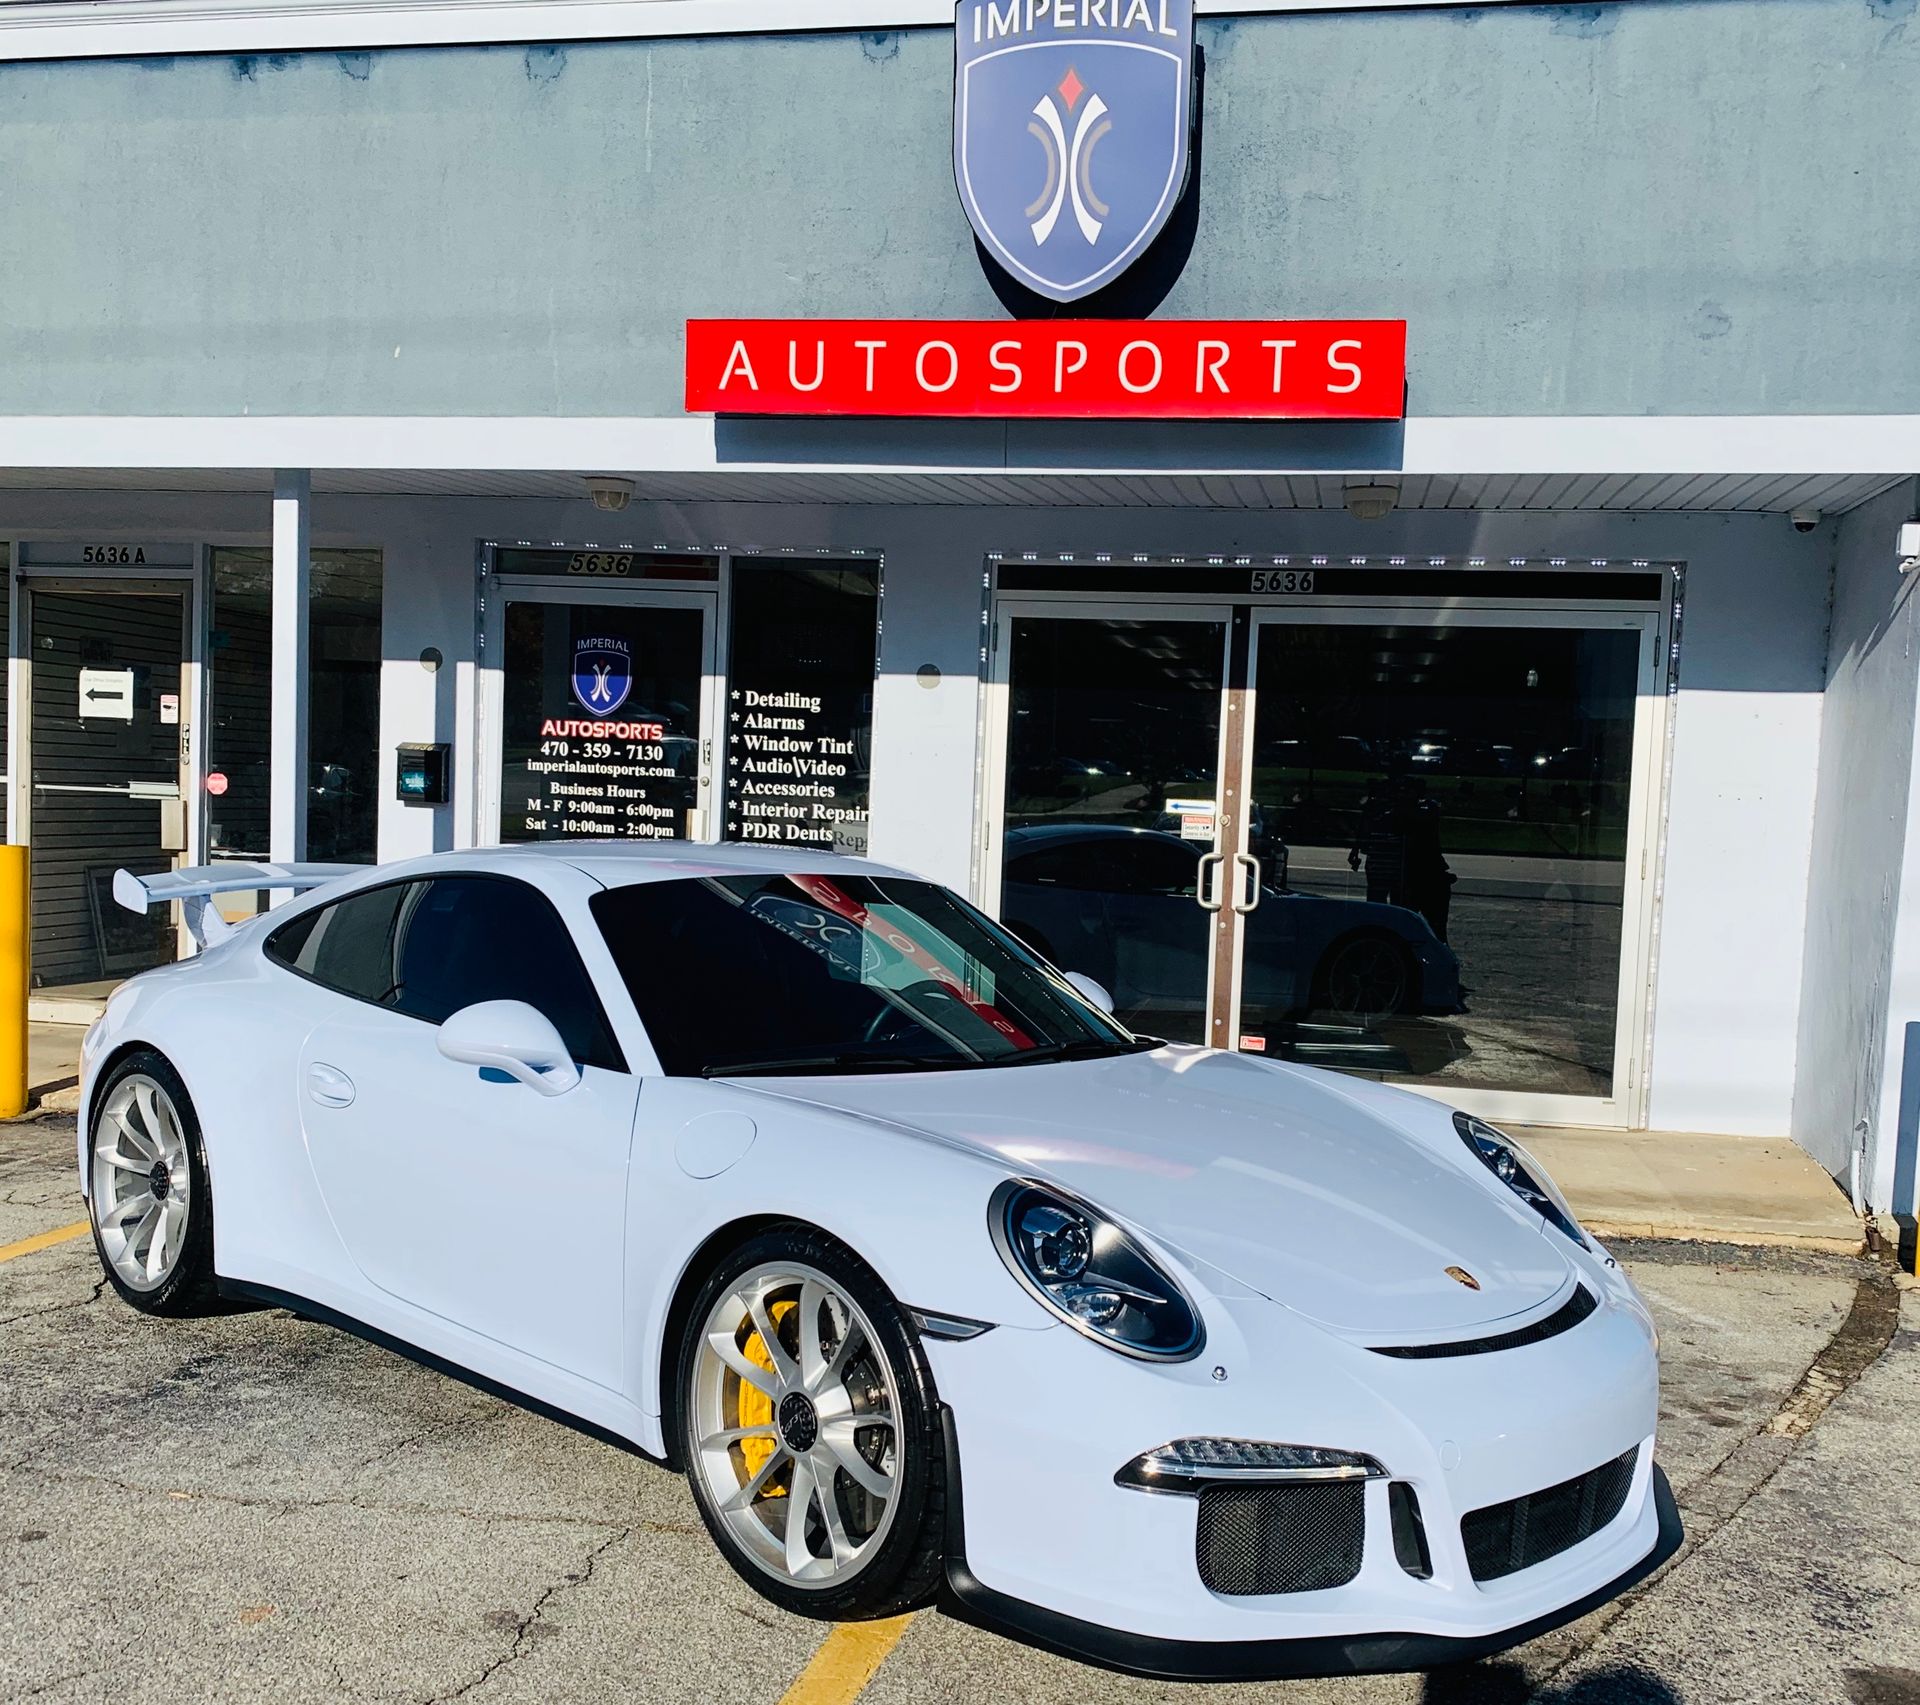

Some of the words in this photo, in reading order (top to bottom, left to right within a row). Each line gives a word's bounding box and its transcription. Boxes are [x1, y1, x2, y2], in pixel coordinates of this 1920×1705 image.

[974, 0, 1178, 43] IMPERIAL
[718, 339, 1364, 395] AUTOSPORTS
[83, 546, 130, 563] 5636
[134, 547, 146, 563] A
[571, 554, 631, 574] 5636
[1252, 571, 1313, 592] 5636
[577, 638, 630, 653] IMPERIAL
[745, 690, 821, 713] Detailing
[541, 720, 664, 741] AUTOSPORTS
[743, 713, 805, 731] Alarms
[540, 741, 569, 757] 470
[582, 742, 611, 758] 359
[626, 744, 664, 761] 7130
[743, 734, 814, 753] Window
[817, 737, 854, 755] Tint
[527, 759, 676, 778] imperialautosports.com
[742, 756, 846, 778] Audio\Video
[550, 782, 604, 797] Business
[606, 784, 646, 799] Hours
[741, 779, 835, 798] Accessories
[527, 799, 541, 811] M
[553, 800, 563, 812] F
[568, 801, 615, 815] 9:00am
[626, 804, 674, 820] 6:00pm
[742, 800, 808, 819] Interior
[812, 803, 870, 824] Repair
[525, 817, 547, 831] Sat
[562, 819, 615, 834] 10:00am
[627, 823, 674, 839] 2:00pm
[742, 822, 781, 840] PDR
[786, 824, 834, 842] Dents
